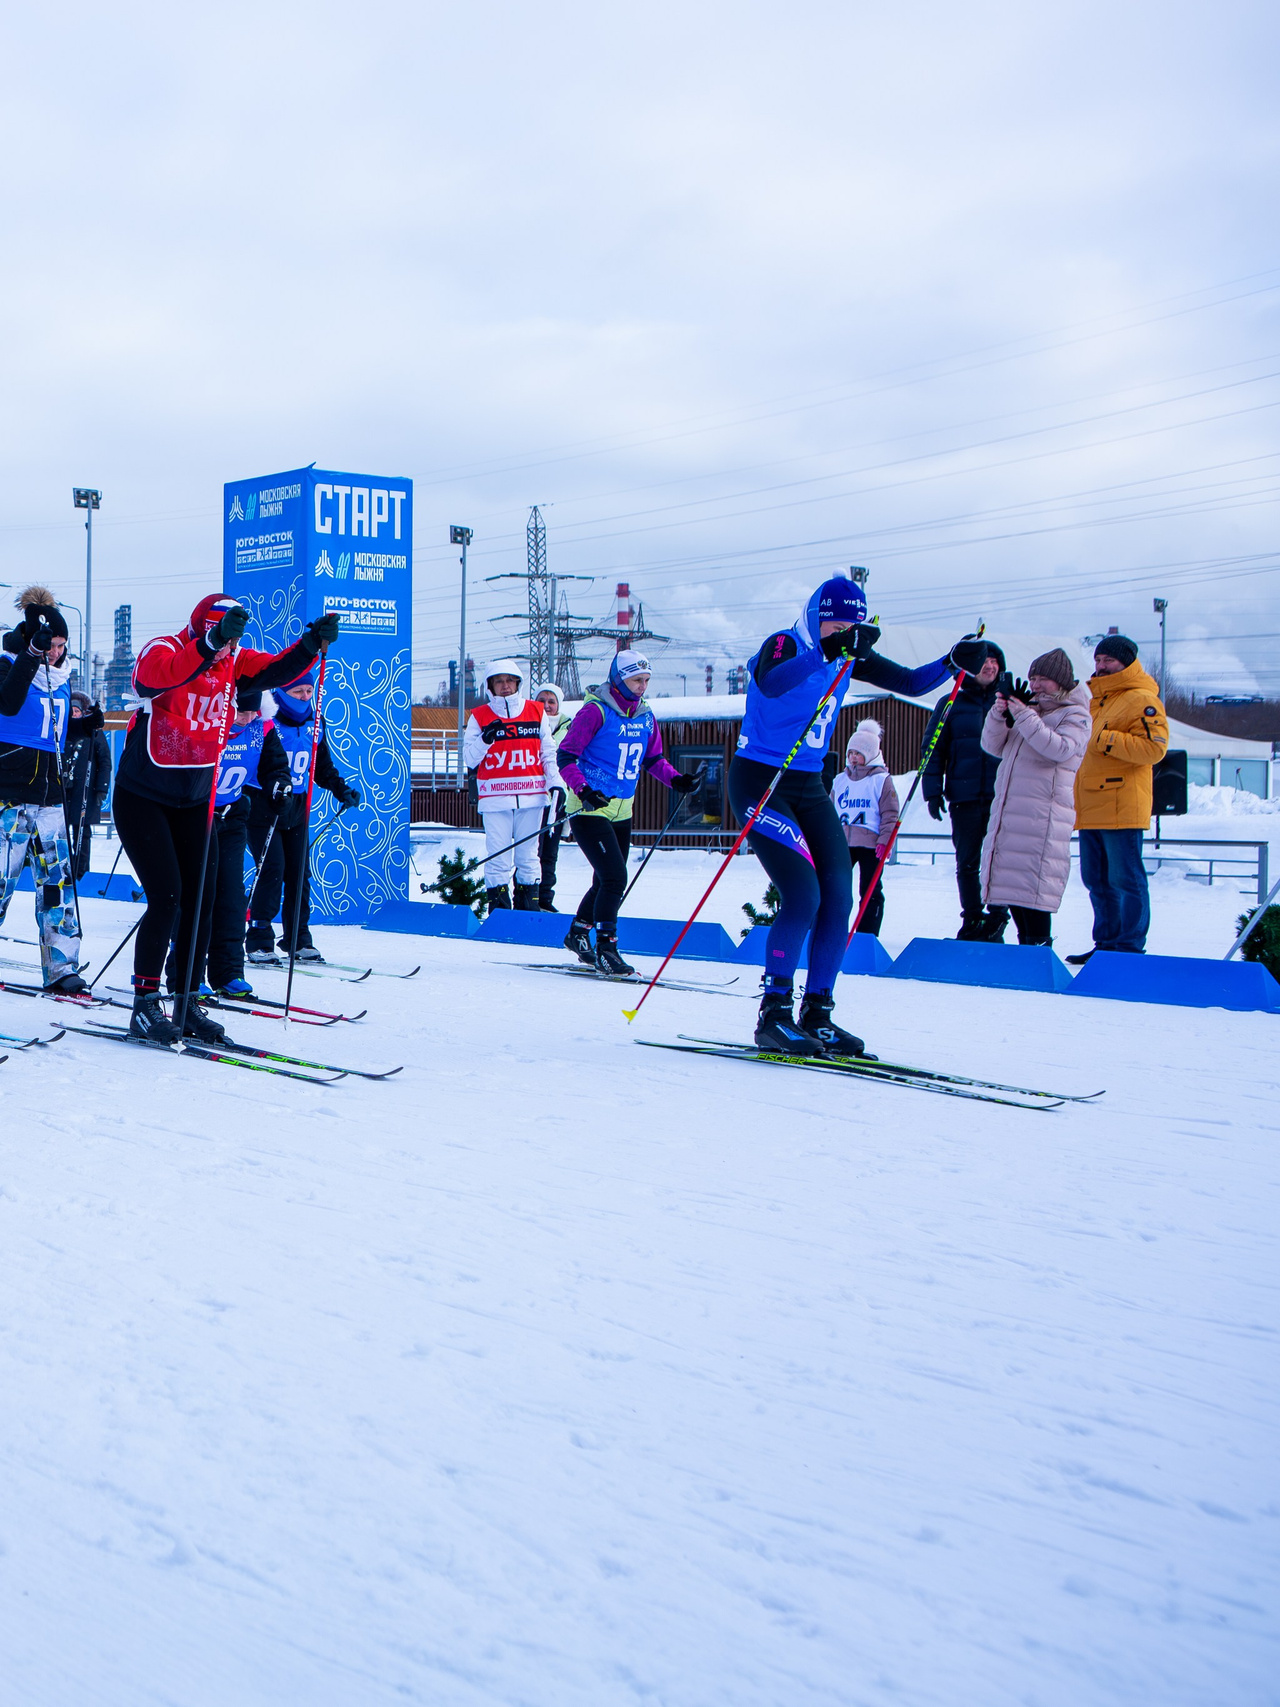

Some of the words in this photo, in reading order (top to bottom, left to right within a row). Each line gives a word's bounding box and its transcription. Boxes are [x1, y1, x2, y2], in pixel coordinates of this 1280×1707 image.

[259, 483, 302, 504] МОСКОВСКАЯ
[259, 501, 283, 518] ЛЫЖНЯ
[314, 483, 407, 540] СТАРТ
[236, 530, 294, 548] ЮГО-ВОСТОК
[354, 551, 407, 569] МОСКОВСКАЯ
[354, 568, 384, 582] ЛЫЖНЯ
[323, 595, 397, 610] ЮГО-ВОСТОК
[40, 697, 65, 742] 17
[218, 682, 231, 745] MADSHUS
[313, 684, 324, 743] MADSHUS
[517, 726, 541, 736] Sport
[929, 721, 945, 750] LEKI
[617, 742, 644, 781] 13
[490, 779, 535, 792] МОСКОВСКИЙ
[745, 805, 812, 857] SPINE
[756, 1053, 807, 1065] FISCHER
